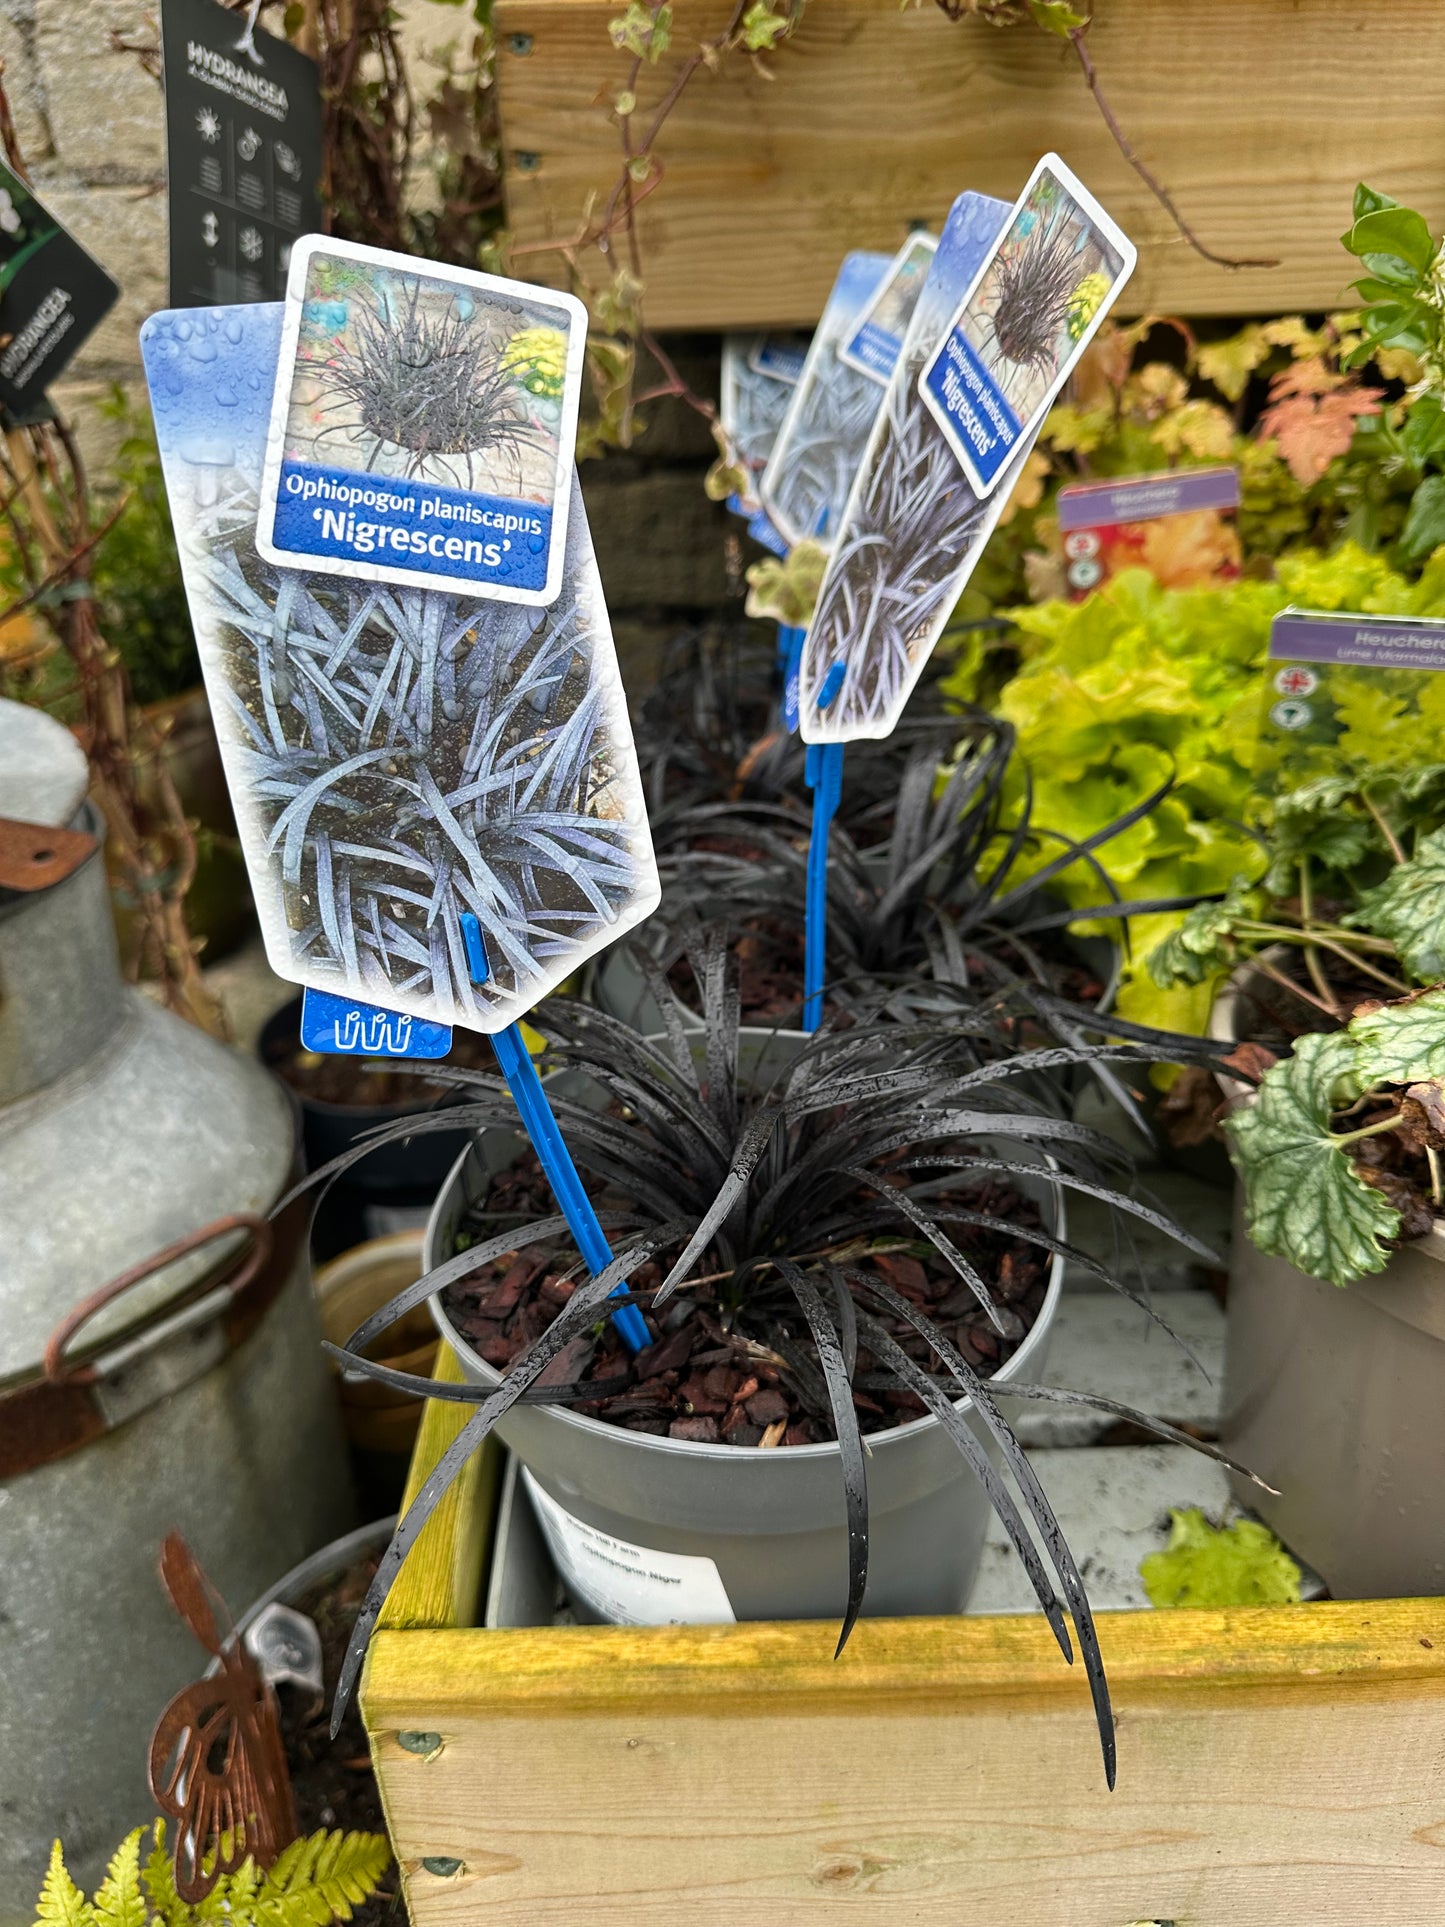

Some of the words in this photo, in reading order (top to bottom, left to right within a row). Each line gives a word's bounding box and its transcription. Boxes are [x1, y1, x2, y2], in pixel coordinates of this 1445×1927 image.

[187, 40, 289, 110] HYDRANGEA
[946, 336, 983, 395] Ophiopogon
[977, 388, 1014, 445] planiscapus
[286, 474, 416, 513] Ophiopogon
[420, 496, 543, 535] planiscapus
[312, 507, 512, 567] ‘Nigrescens’
